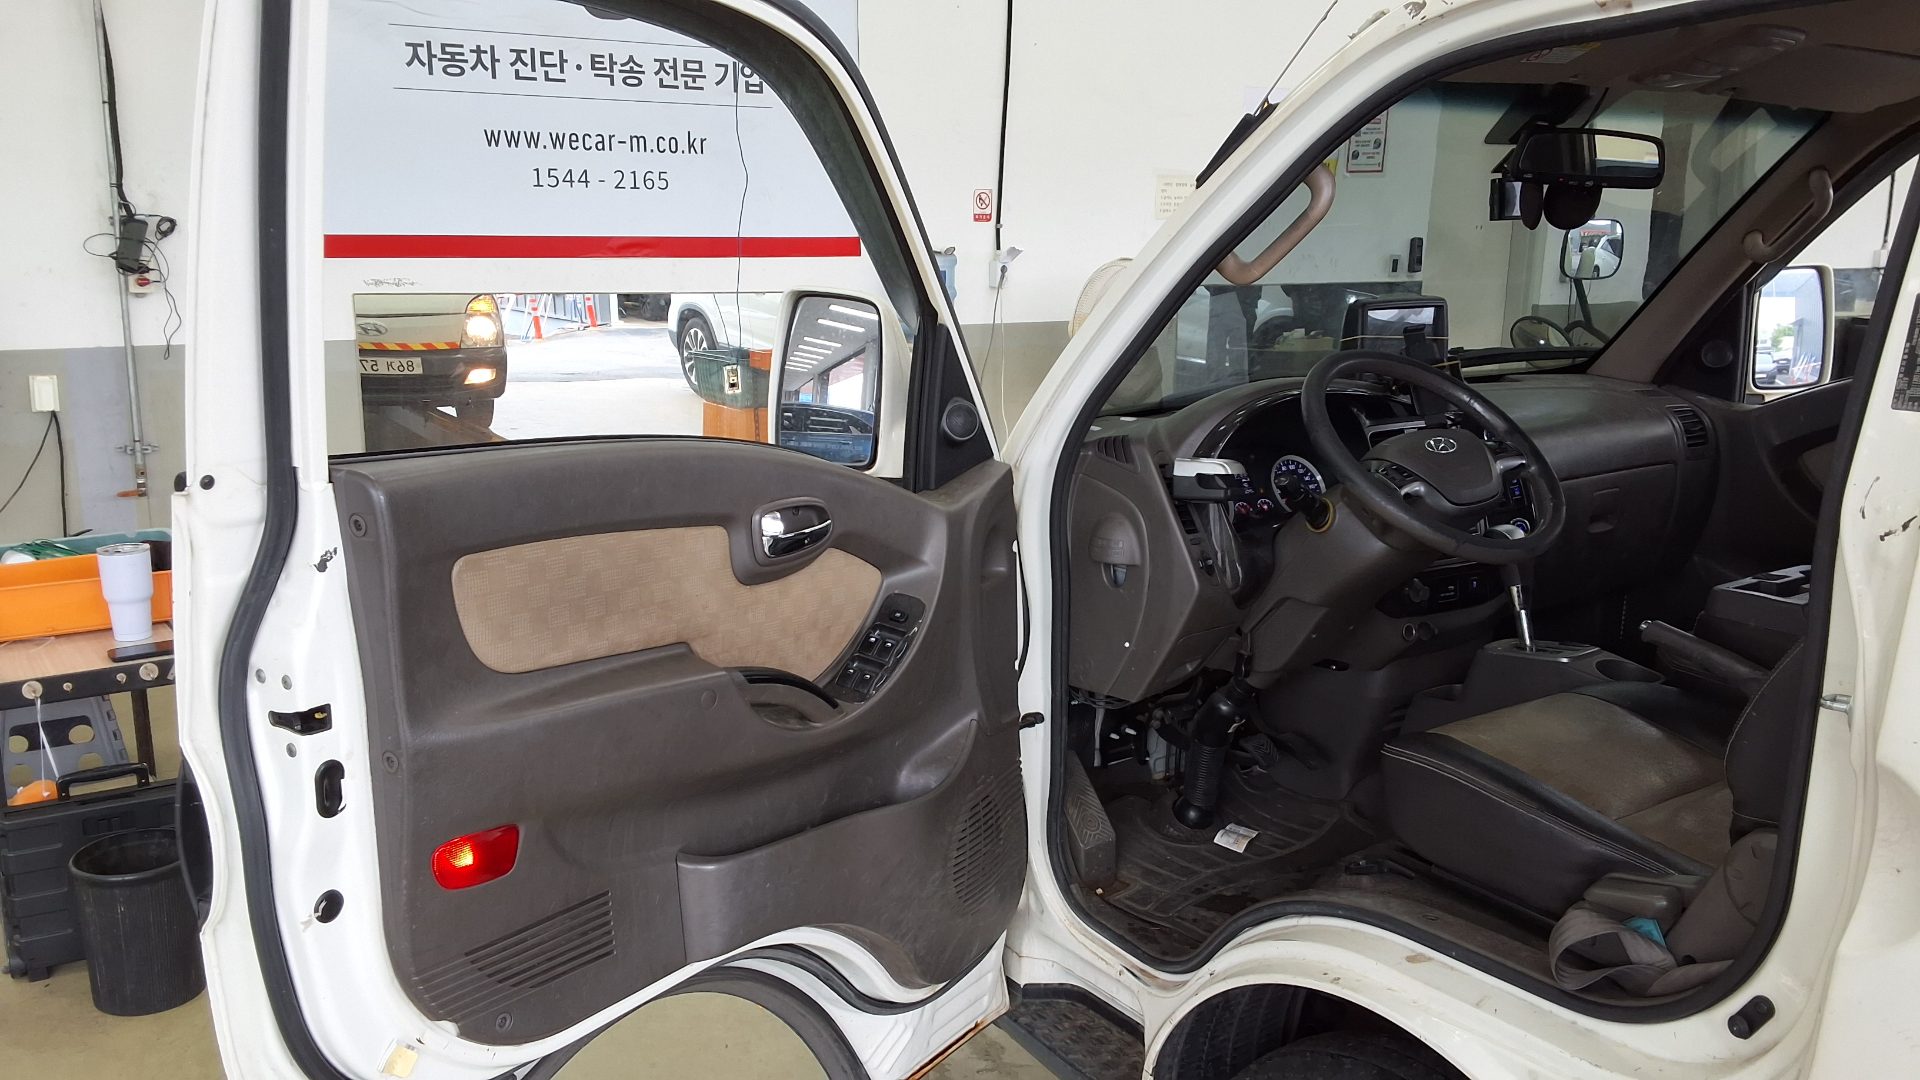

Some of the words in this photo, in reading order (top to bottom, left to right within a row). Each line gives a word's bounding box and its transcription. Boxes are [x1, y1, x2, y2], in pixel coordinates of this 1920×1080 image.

[404, 40, 501, 80] 자동차
[653, 57, 707, 91] 전문
[714, 60, 764, 95] 기업
[483, 128, 707, 155] www.wecar-m.co.kr
